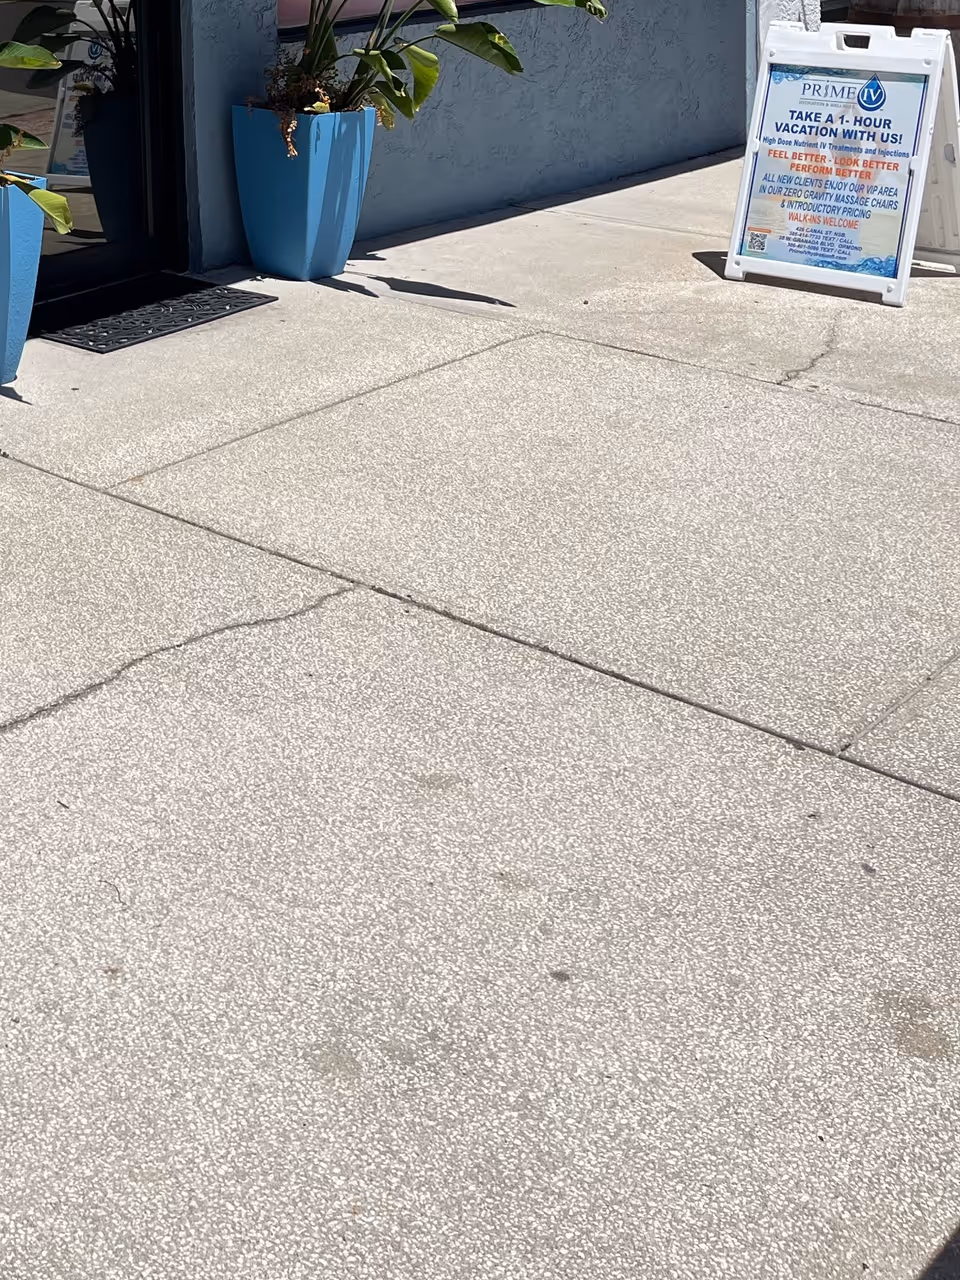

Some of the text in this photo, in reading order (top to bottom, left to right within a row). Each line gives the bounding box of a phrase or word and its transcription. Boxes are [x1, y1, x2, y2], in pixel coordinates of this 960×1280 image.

[801, 80, 882, 101] PRIME IV
[789, 110, 822, 122] TAKE
[825, 114, 834, 124] A
[854, 116, 892, 129] HOUR
[775, 122, 903, 144] VACATION WITH US!
[762, 136, 910, 158] High Dose Nutrient IV Treatments and Injections
[768, 149, 789, 159] FEEL
[792, 151, 826, 163] BETTER
[834, 156, 859, 167] LOOK
[863, 159, 899, 171] BETTER
[790, 163, 872, 180] PERFORM BETTER
[762, 173, 898, 197] ALL NEW CLIENTS ENJOY OUR VIP AREA
[759, 185, 899, 210] IN OUR ZERO GRAVITY MASSAGE CHAIRS
[780, 199, 872, 219] & INTRODUCTORY PRICING
[788, 212, 859, 229] WALK-INS WELCOME
